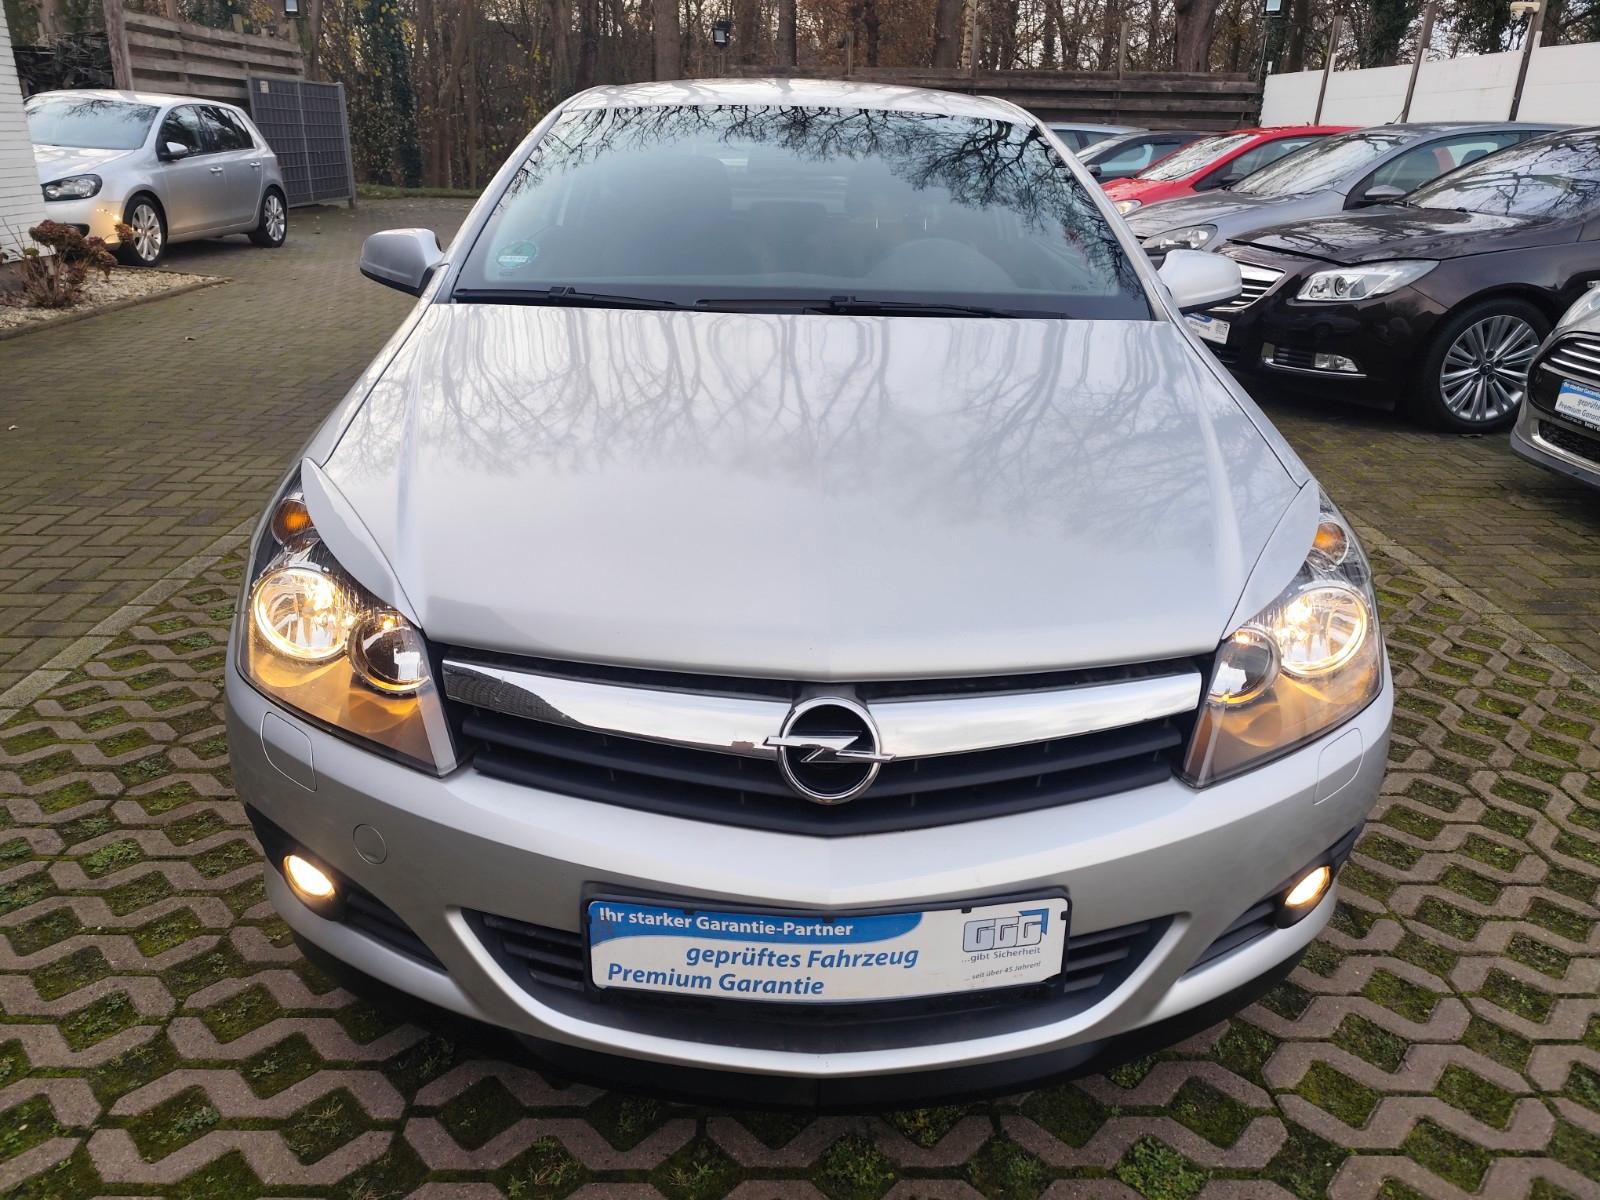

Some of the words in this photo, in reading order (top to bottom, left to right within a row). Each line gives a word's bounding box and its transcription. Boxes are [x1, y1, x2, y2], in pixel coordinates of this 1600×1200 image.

[600, 907, 624, 922] Ihr
[629, 912, 692, 928] starker
[696, 916, 853, 936] Garantie-Partner
[686, 947, 801, 968] geprüftes
[807, 949, 919, 968] Fahrzeug
[993, 946, 1041, 959] Sicherheit
[608, 963, 712, 989] Premium
[719, 973, 824, 994] Garantie
